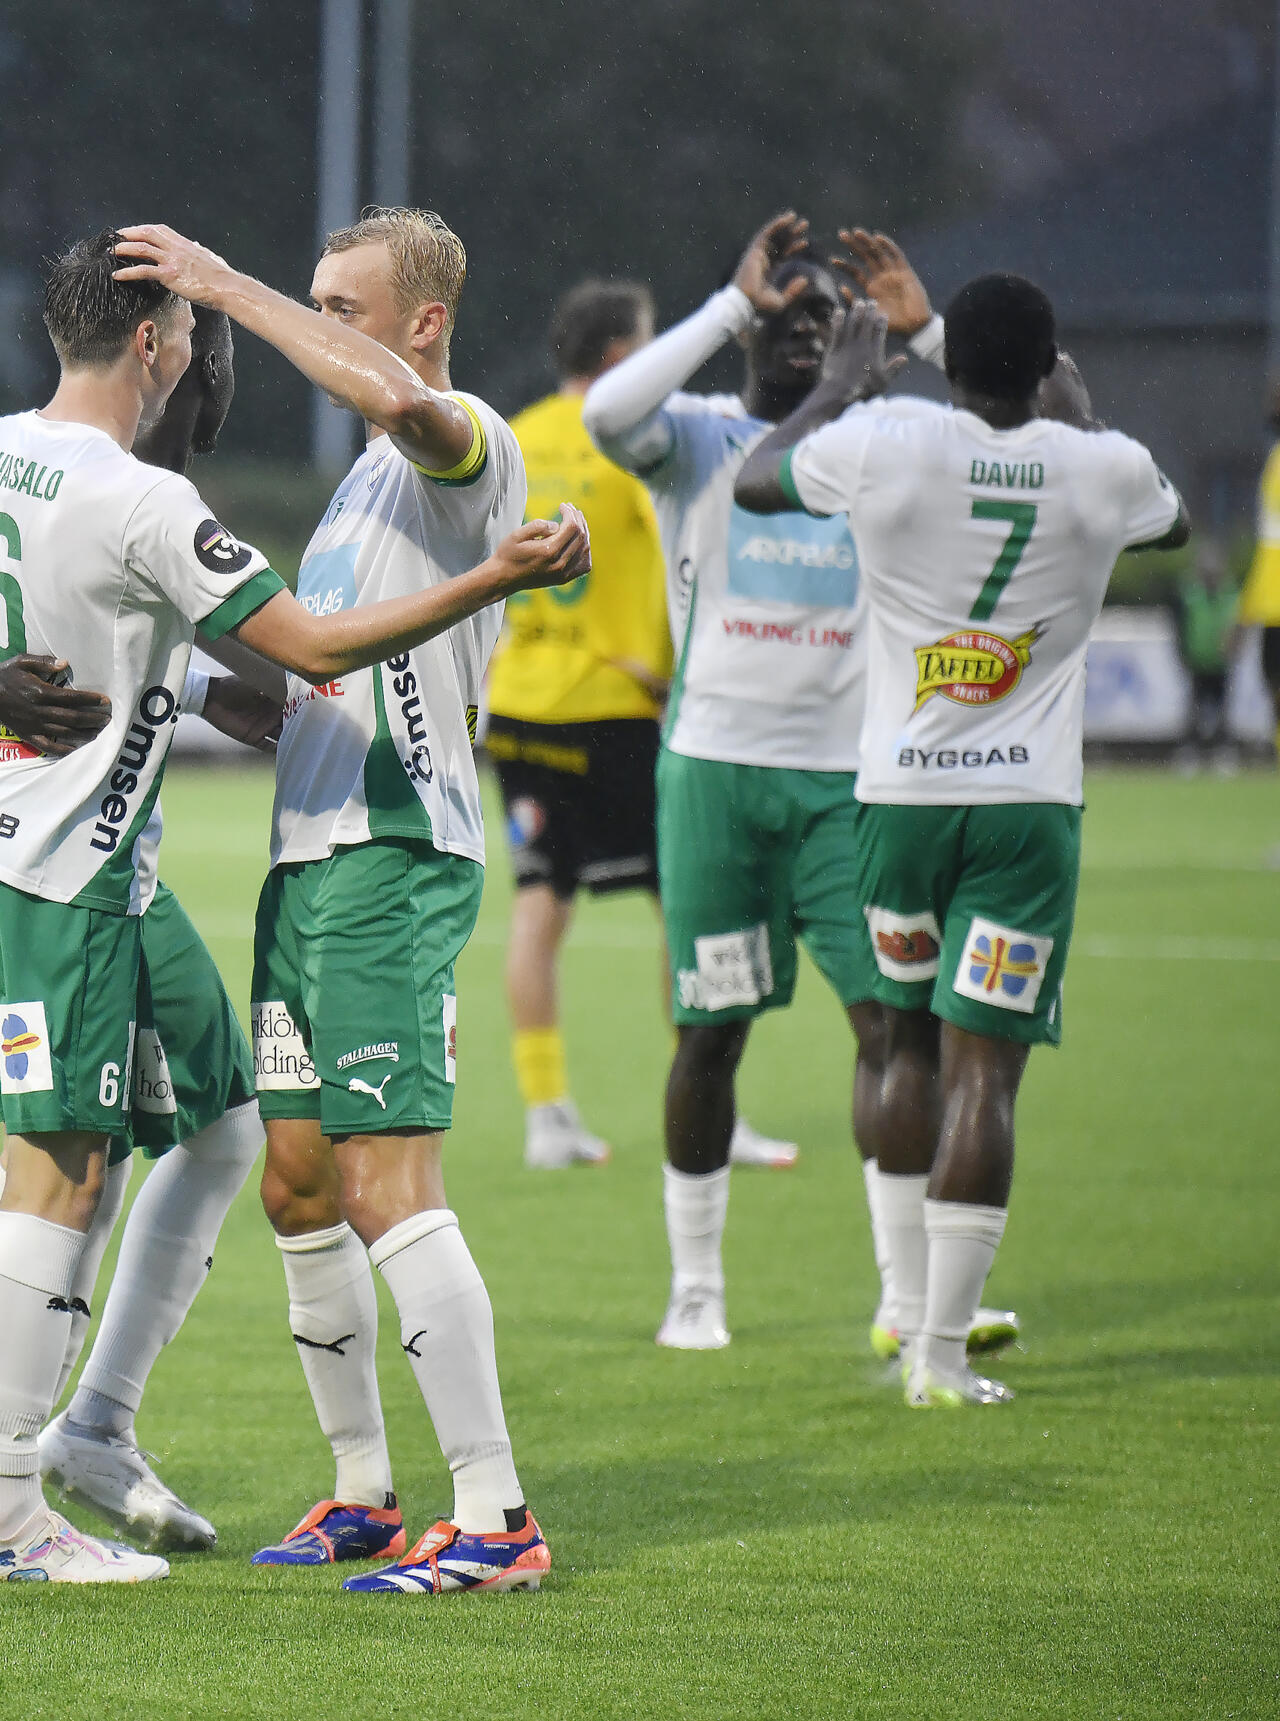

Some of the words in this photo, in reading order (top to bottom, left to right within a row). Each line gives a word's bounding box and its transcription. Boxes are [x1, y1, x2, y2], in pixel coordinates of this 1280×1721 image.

[971, 459, 1045, 490] DAVID
[969, 500, 1037, 622] 7
[723, 618, 802, 646] VIKING
[920, 653, 998, 682] TAFFEL
[387, 652, 434, 785] Ömse
[90, 685, 182, 853] Ömsen
[898, 746, 1029, 769] BYGGAB
[254, 1045, 317, 1084] olding
[336, 1042, 398, 1070] STALLHAGEN
[99, 1062, 120, 1107] 6
